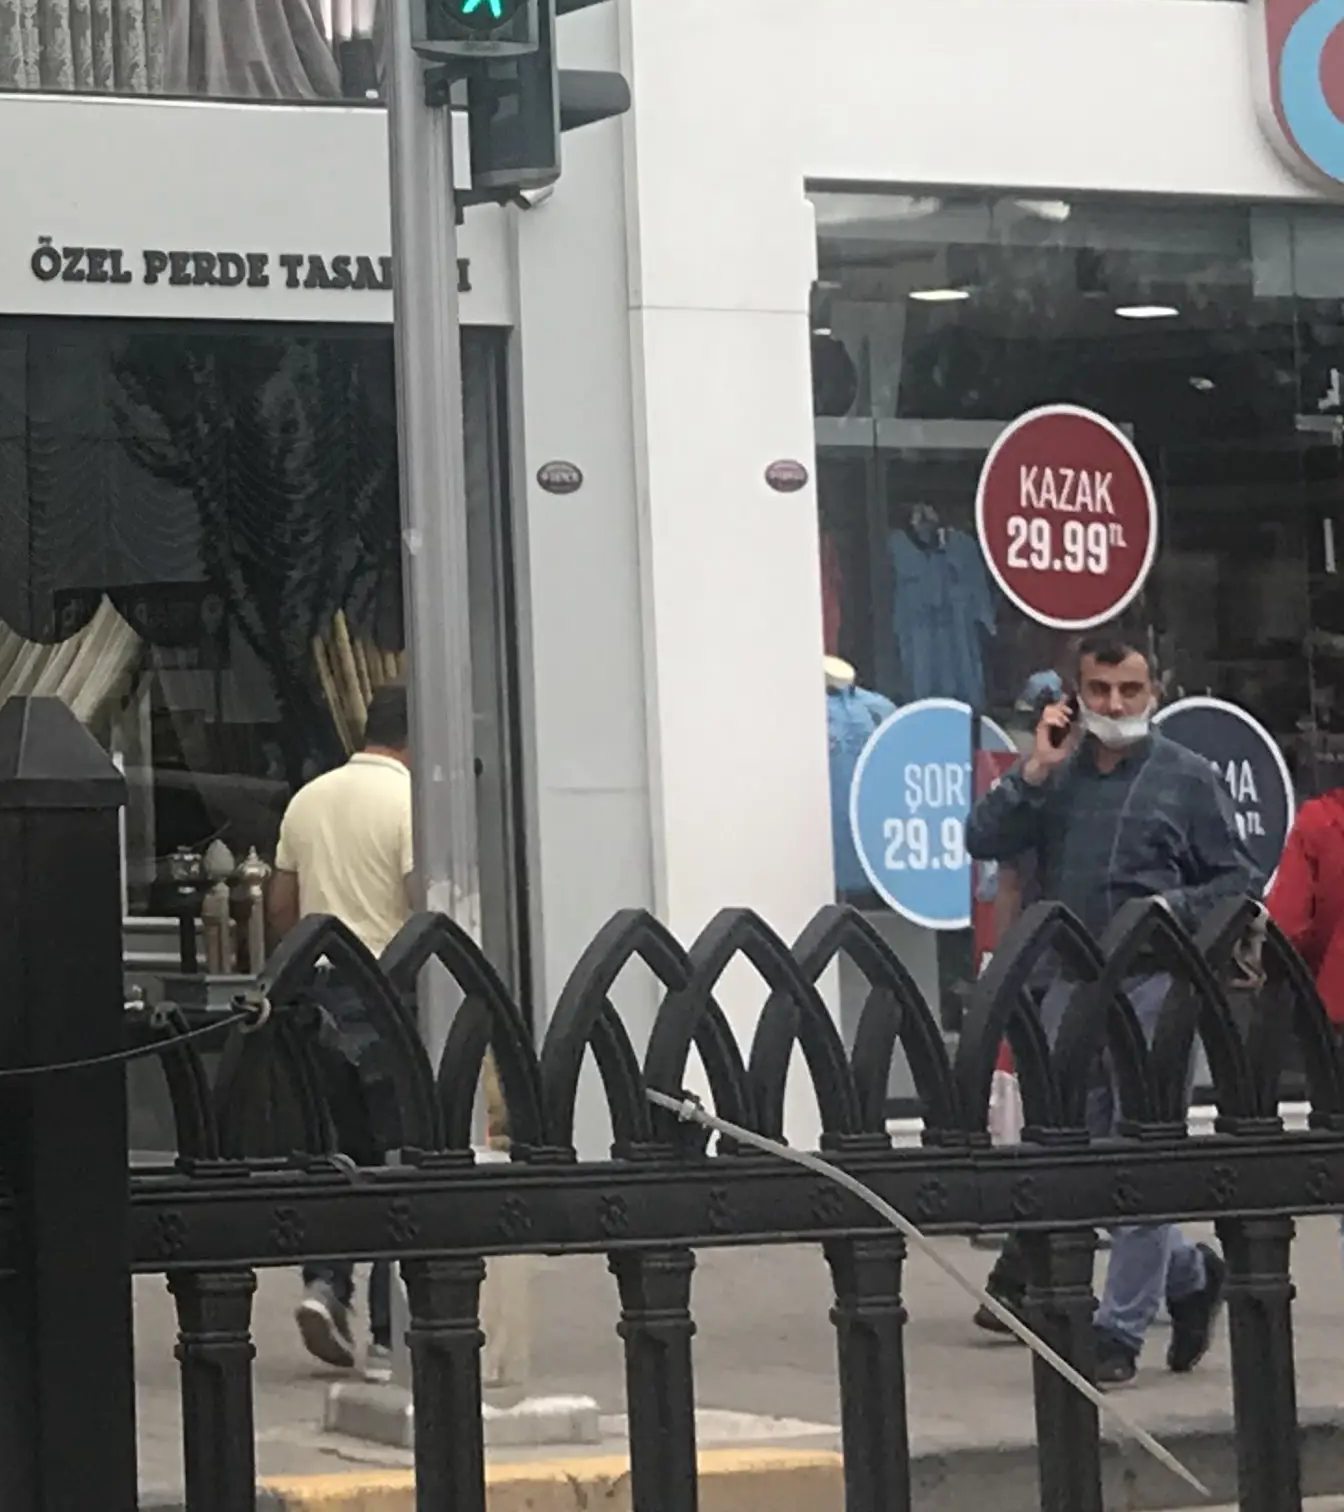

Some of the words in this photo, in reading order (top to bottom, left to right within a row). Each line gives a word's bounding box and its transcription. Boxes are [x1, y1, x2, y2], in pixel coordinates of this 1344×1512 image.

[30, 236, 132, 284] ÖZEL
[143, 249, 269, 288] PERDE
[1019, 464, 1116, 516] KAZAK
[882, 815, 973, 871] 29.9
